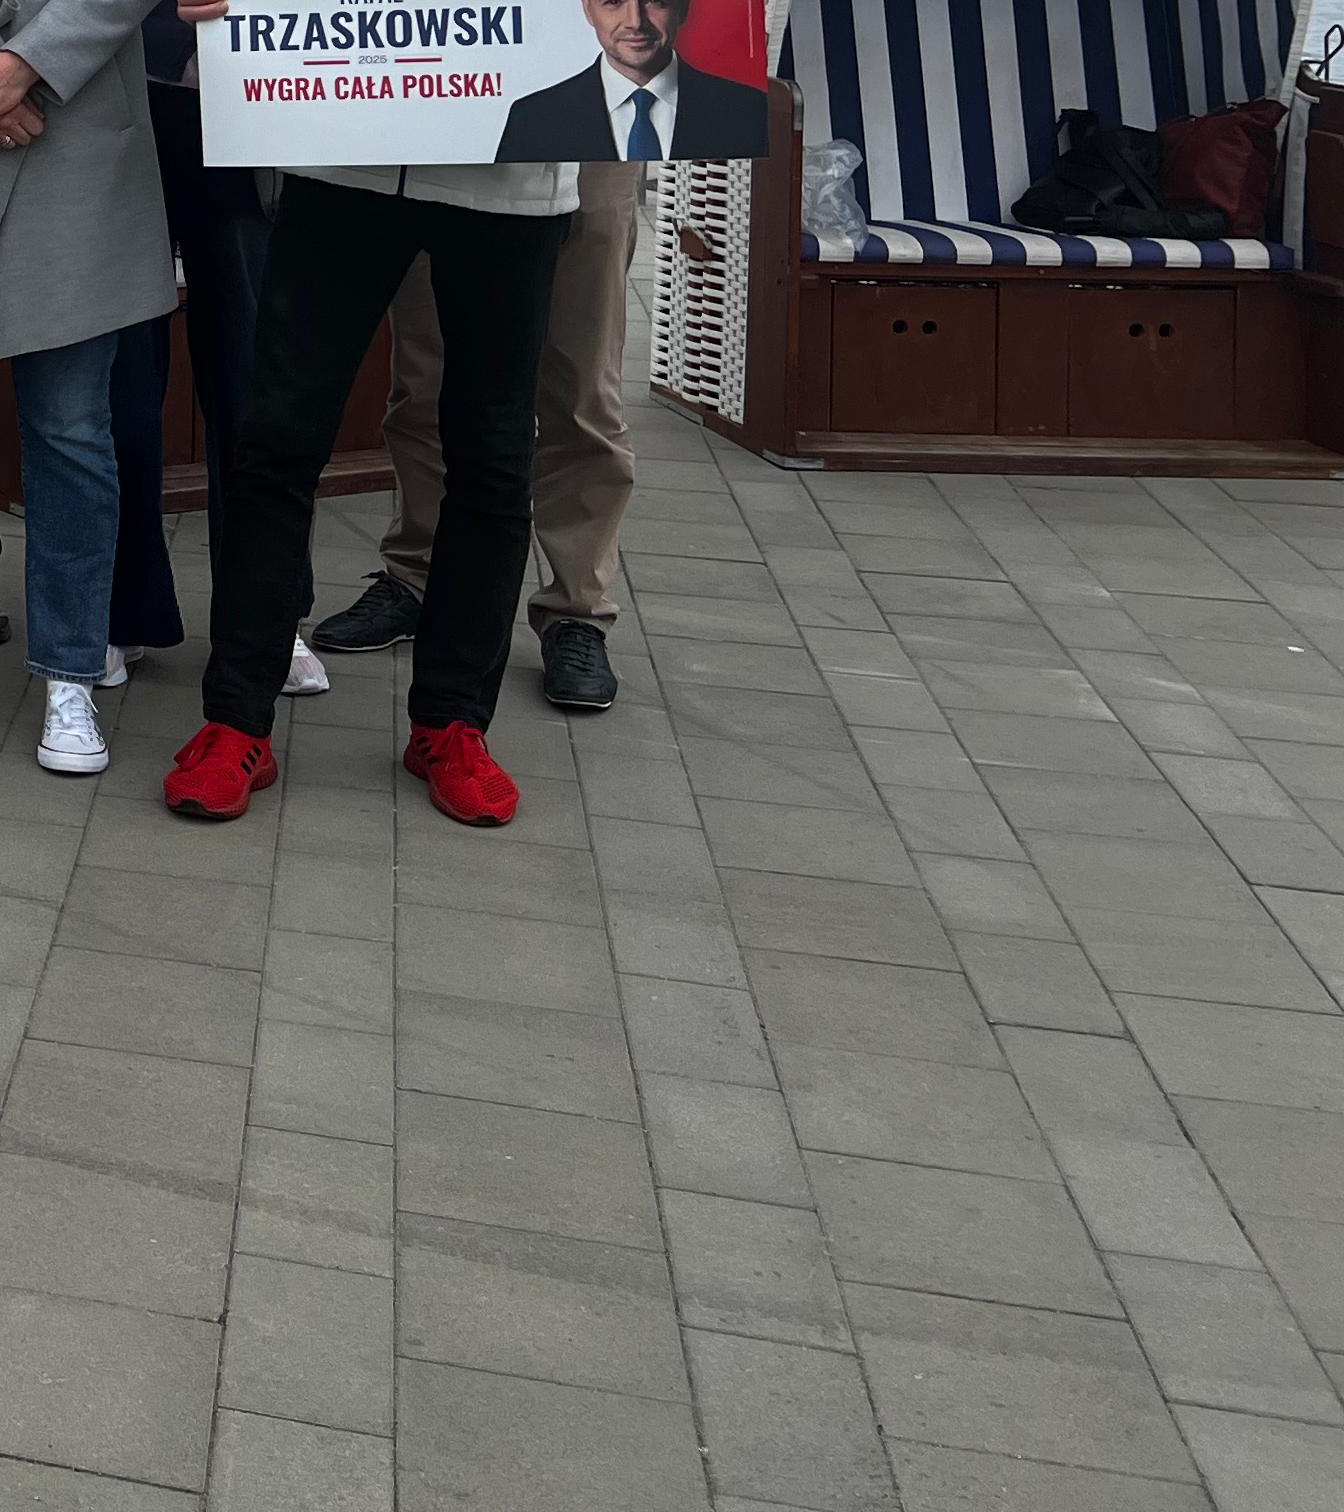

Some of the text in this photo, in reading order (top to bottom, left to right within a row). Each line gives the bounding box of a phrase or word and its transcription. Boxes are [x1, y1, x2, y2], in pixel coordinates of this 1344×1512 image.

[224, 6, 523, 52] TRZASKOWSKI
[358, 55, 387, 65] 2025
[243, 72, 502, 102] WYGRA CAŁA POLSKA!
